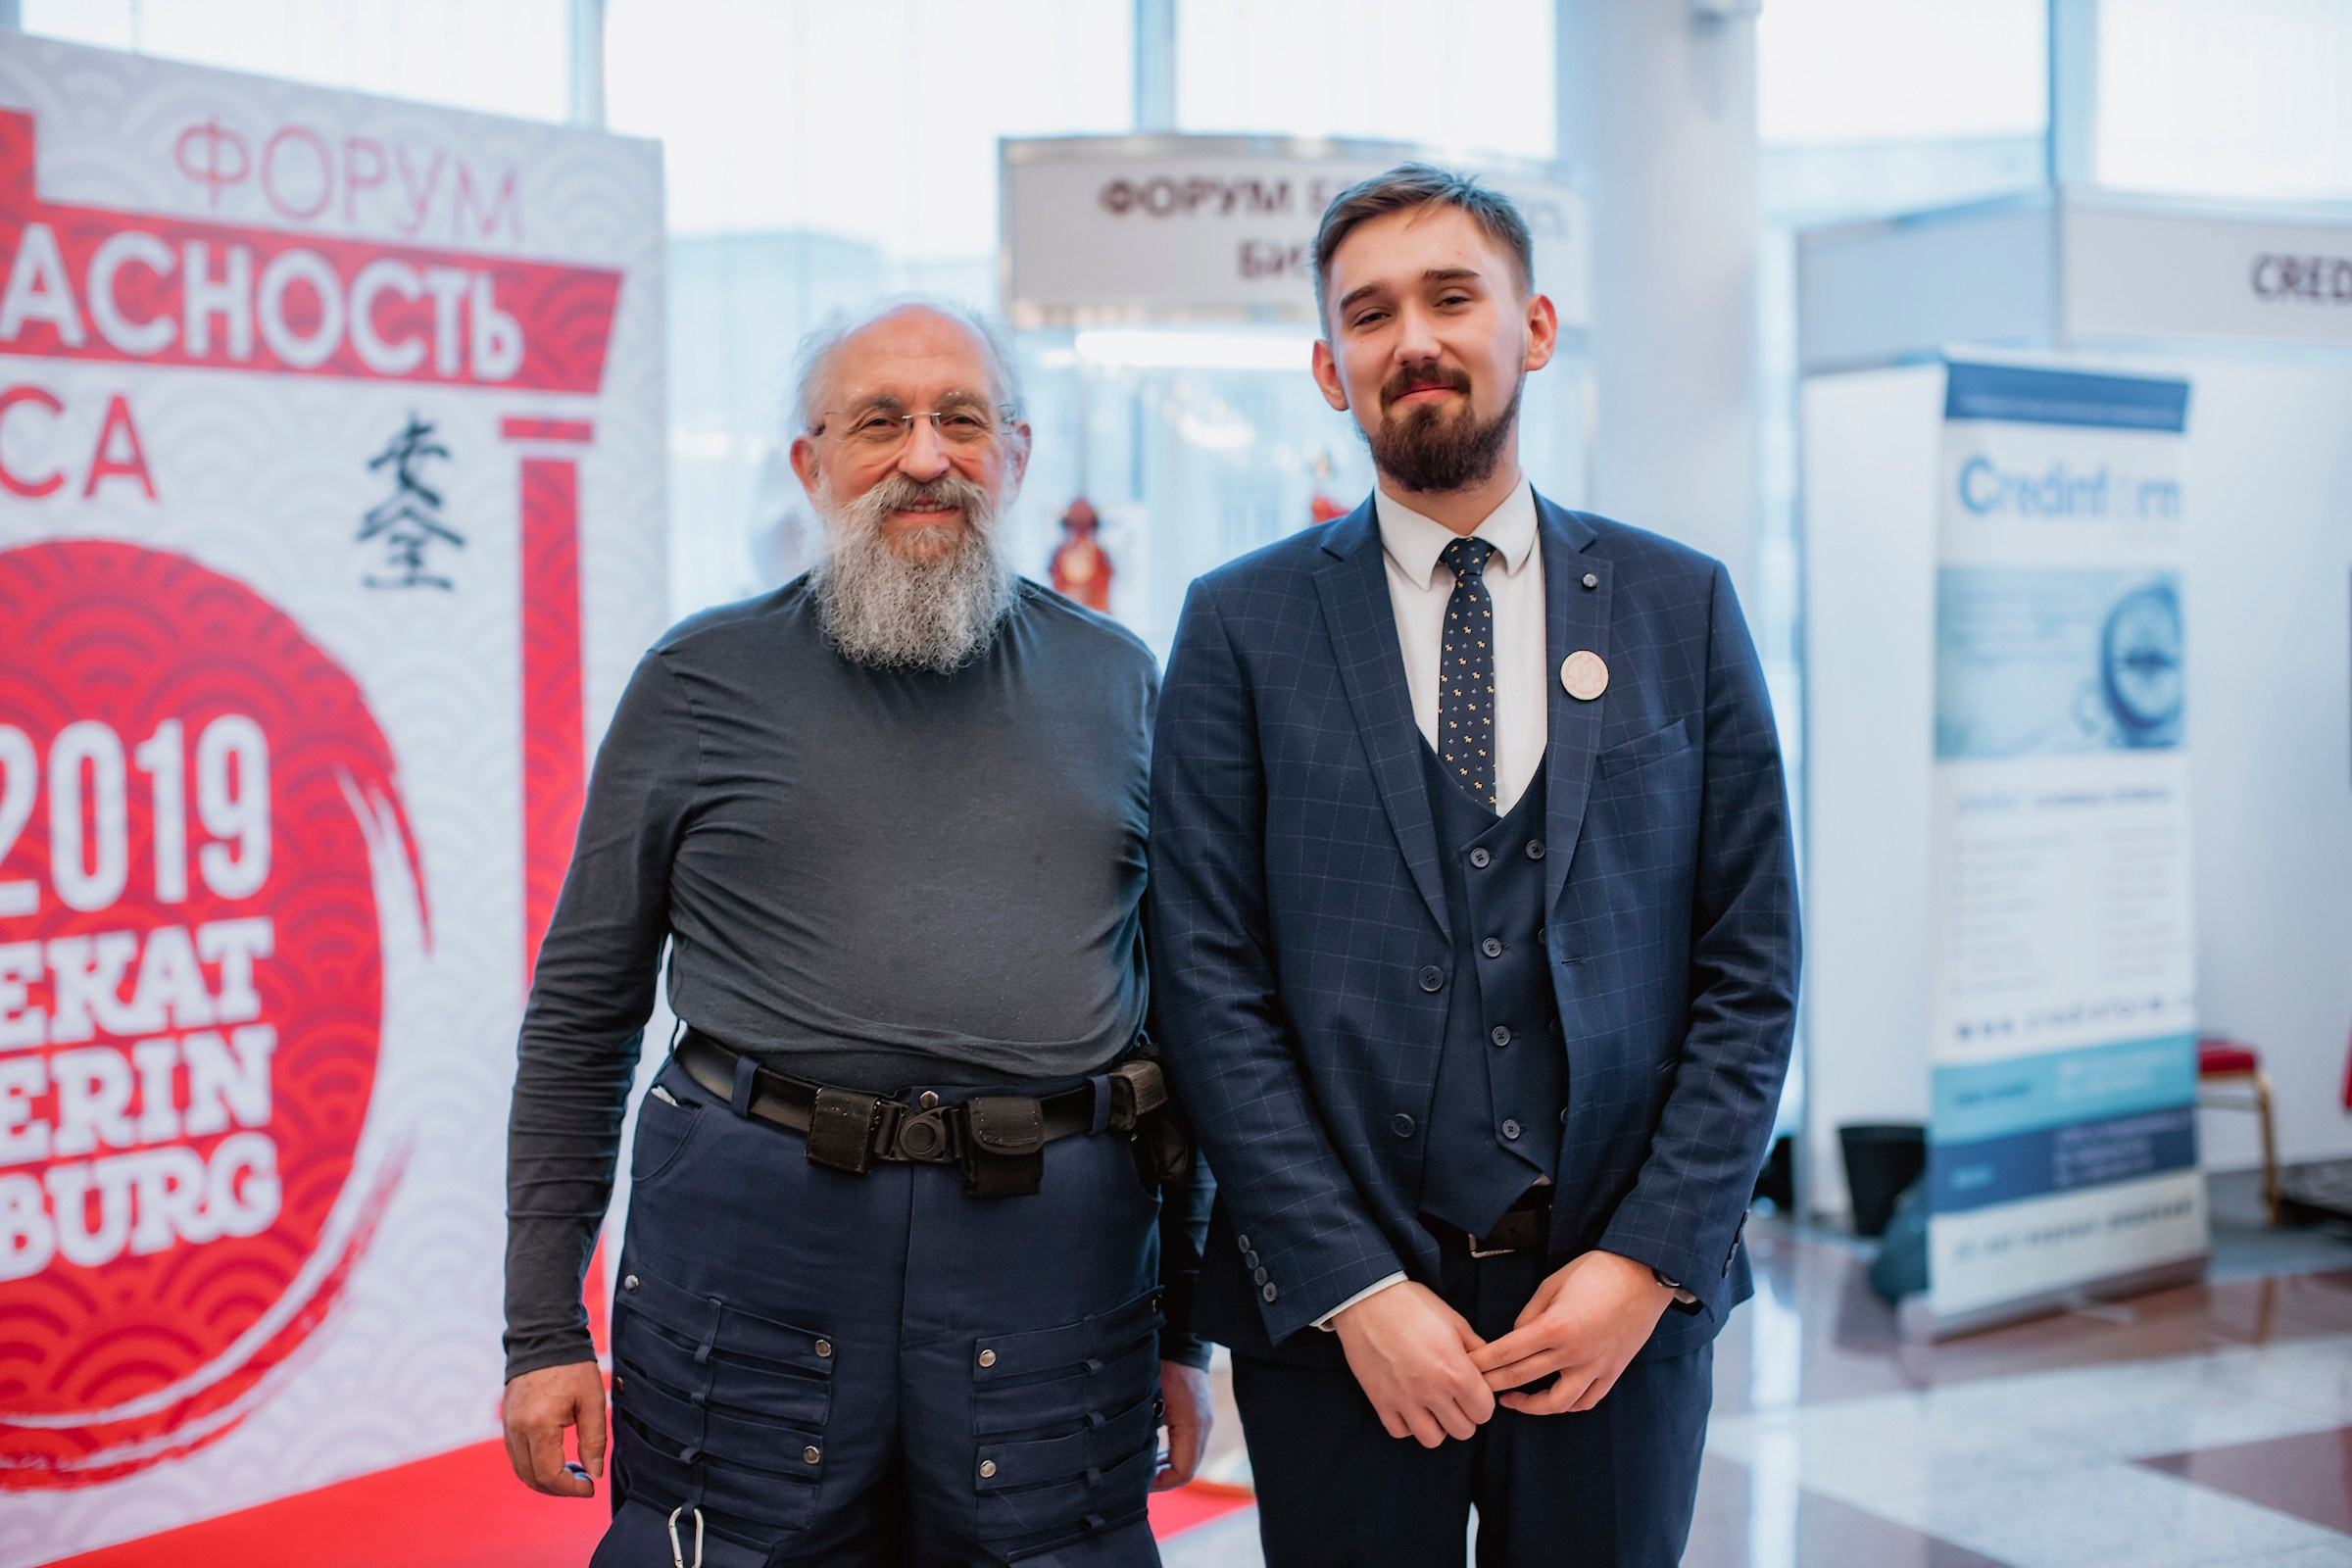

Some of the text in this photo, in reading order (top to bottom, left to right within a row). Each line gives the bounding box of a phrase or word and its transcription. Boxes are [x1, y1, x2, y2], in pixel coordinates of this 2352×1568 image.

[172, 114, 526, 244] ФОРУМ
[1099, 175, 1293, 219] ФОРУМ
[0, 220, 525, 381] АСНОСТЬ
[1958, 454, 2180, 519] Credinfrm
[0, 1024, 278, 1167] ERIN
[0, 1131, 283, 1281] BURG
